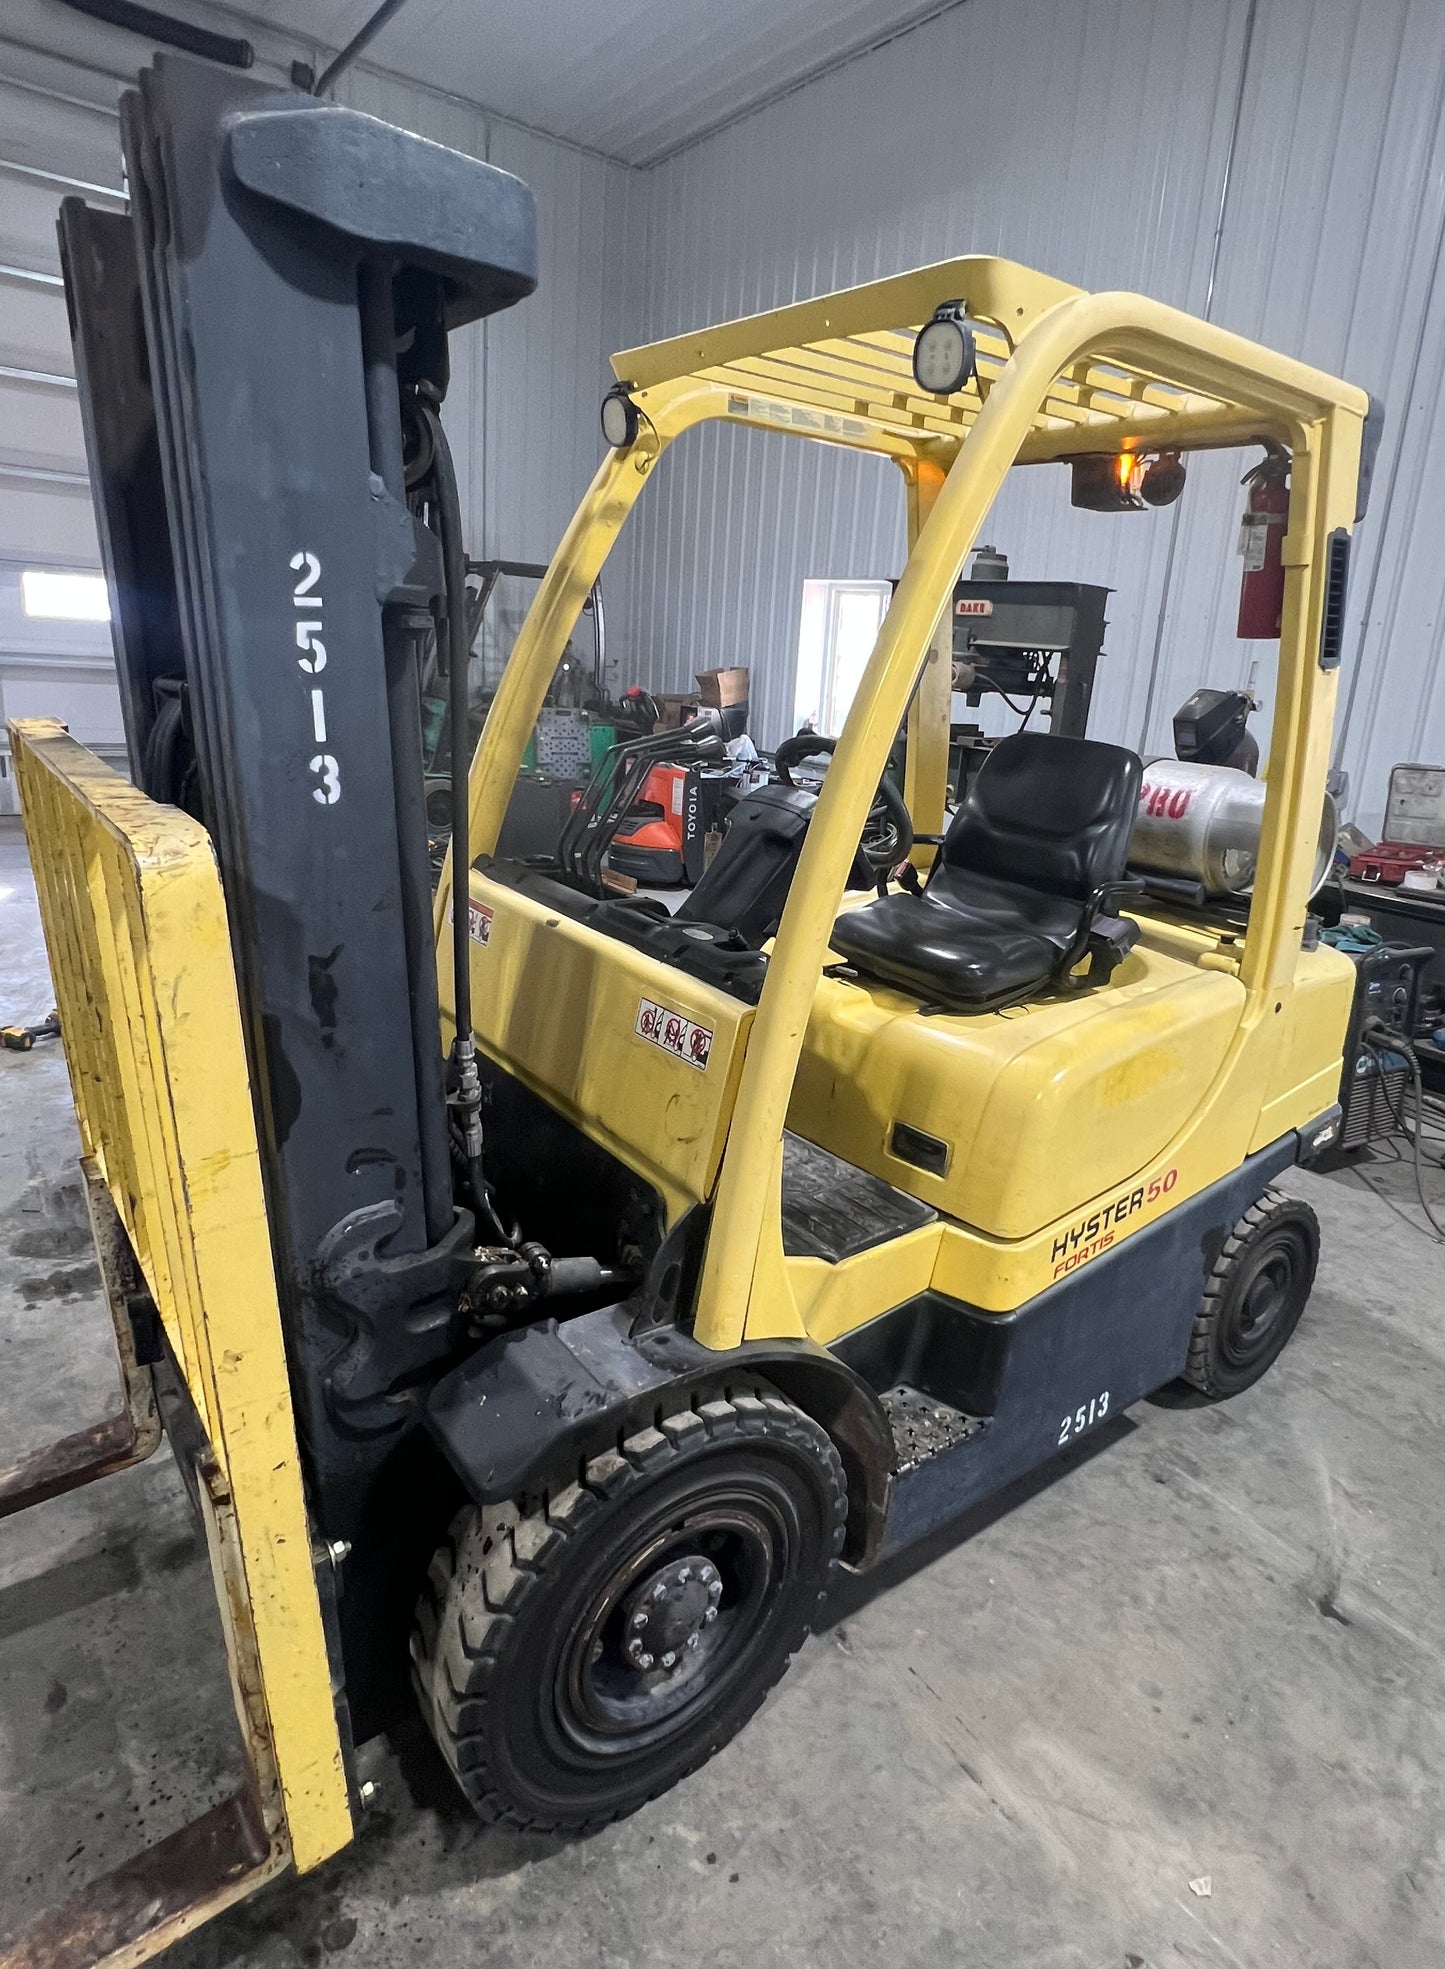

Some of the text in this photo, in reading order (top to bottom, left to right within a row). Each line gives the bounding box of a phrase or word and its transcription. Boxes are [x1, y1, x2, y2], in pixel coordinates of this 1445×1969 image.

[289, 552, 341, 804] 2513
[1051, 1169, 1177, 1263] HYSTER 50
[1053, 1229, 1115, 1279] FORTIS
[1057, 1391, 1109, 1446] 2513
